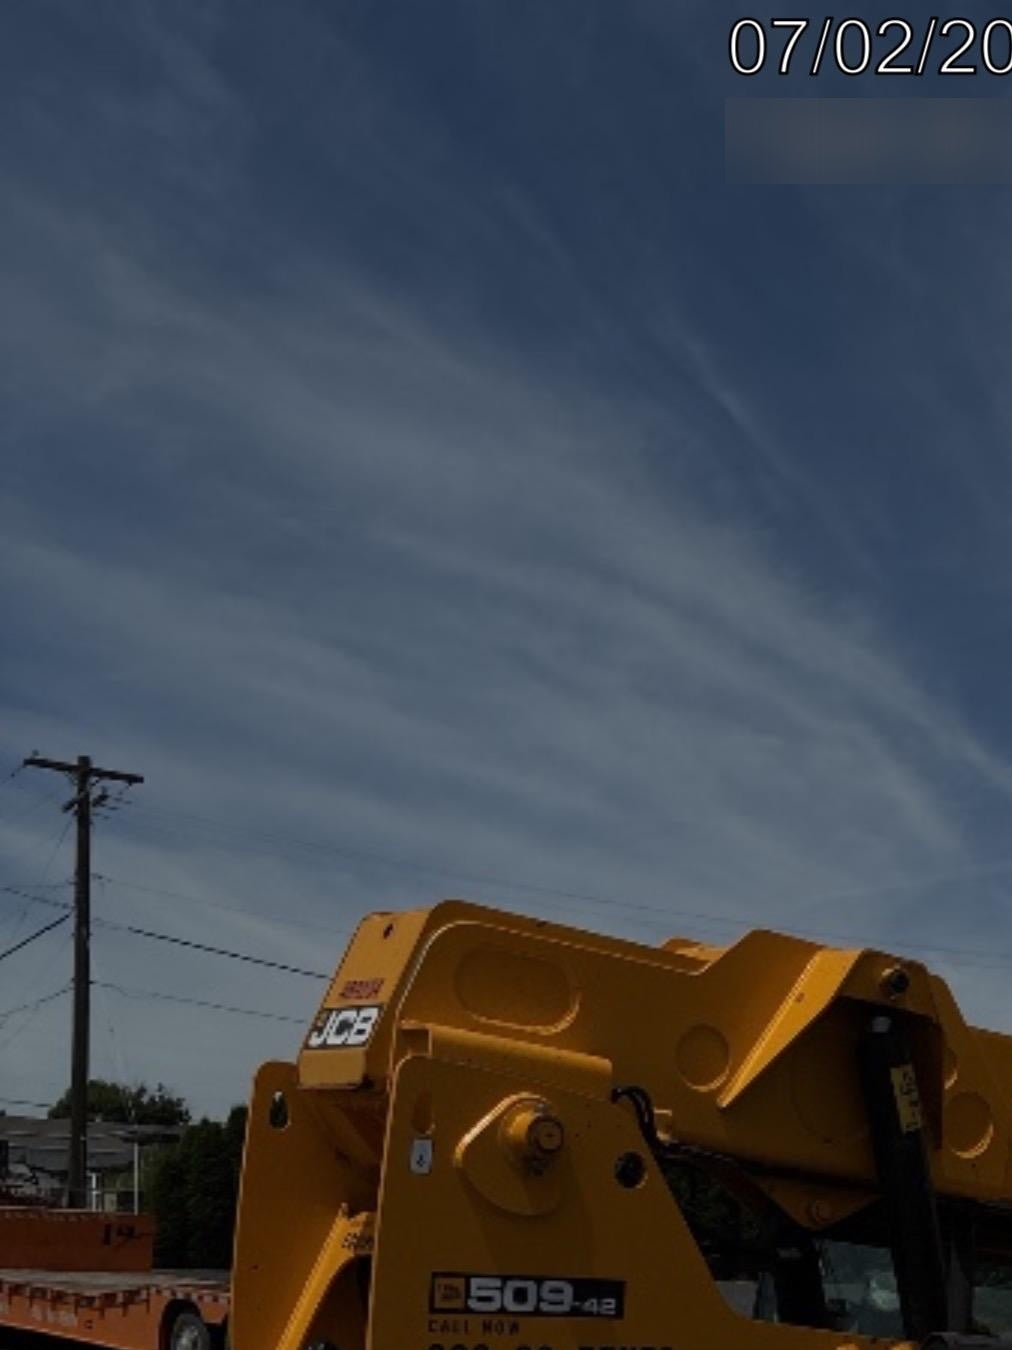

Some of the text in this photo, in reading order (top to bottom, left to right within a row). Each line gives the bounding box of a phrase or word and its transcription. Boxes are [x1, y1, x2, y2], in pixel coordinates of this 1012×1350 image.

[307, 1006, 381, 1048] JCB
[466, 1275, 618, 1316] 509-42
[427, 1318, 521, 1336] CALL NOW
